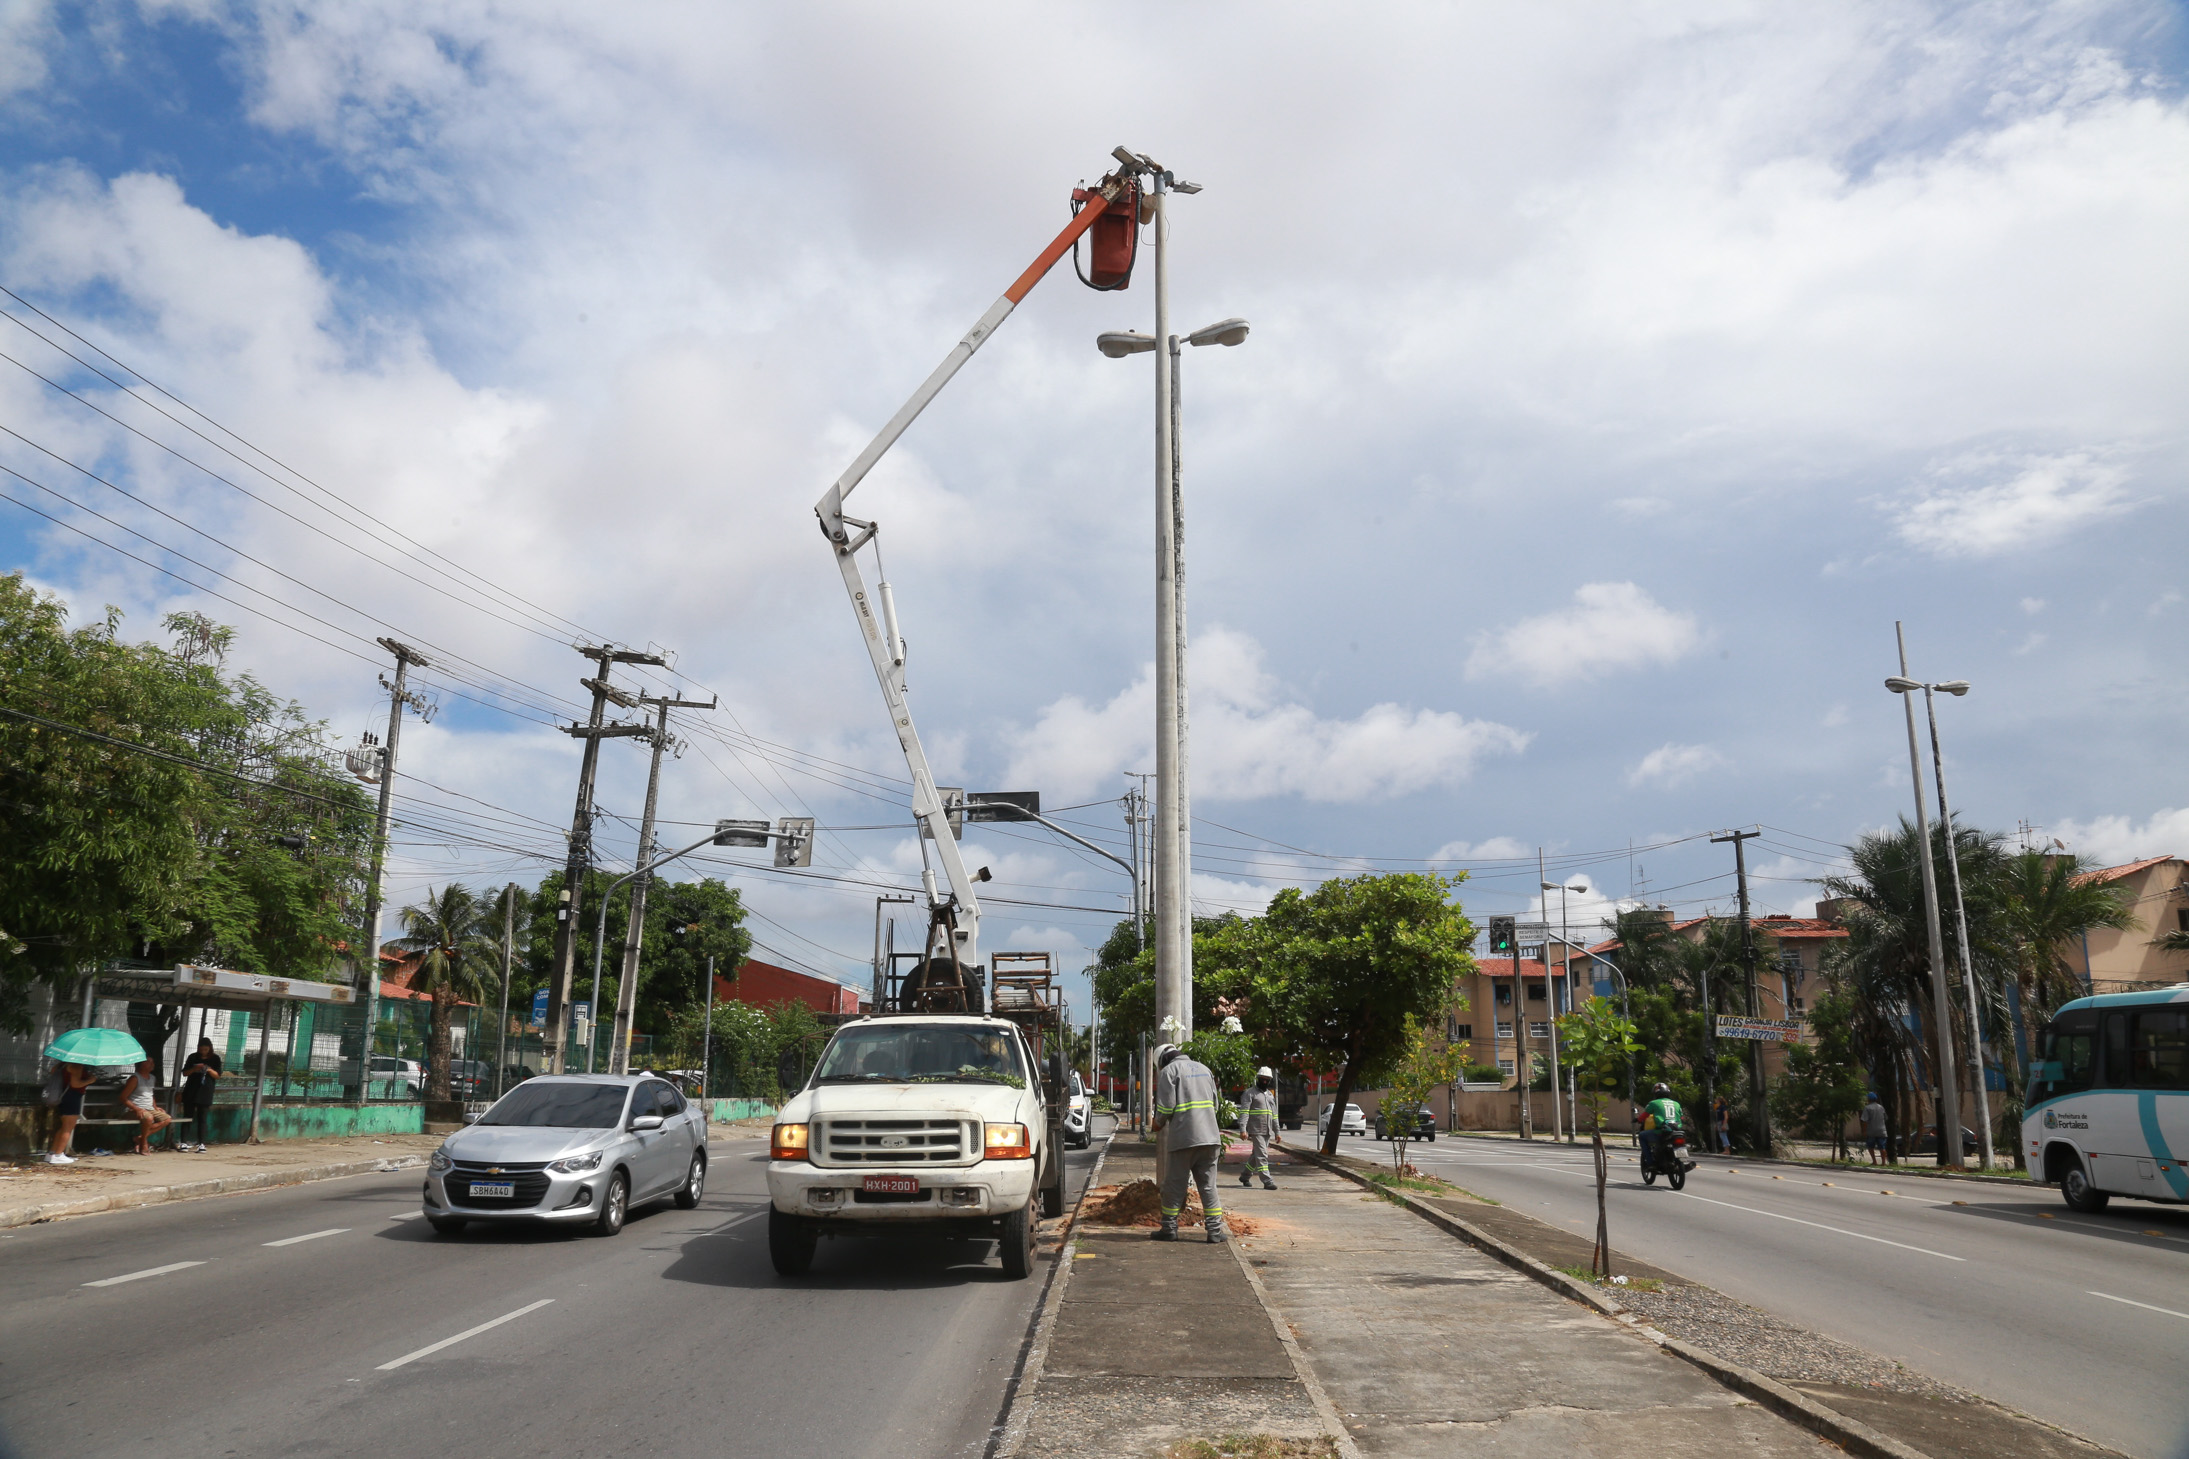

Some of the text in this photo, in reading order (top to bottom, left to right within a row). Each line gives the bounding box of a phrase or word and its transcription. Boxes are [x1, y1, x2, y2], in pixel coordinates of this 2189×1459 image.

[1719, 1016, 1799, 1028] LOTES GRANJA LISBOA
[1725, 1028, 1775, 1040] 99619-6770
[1664, 1105, 1675, 1118] 10
[2058, 1120, 2088, 1129] Fortaleza
[474, 1186, 508, 1195] SBH6A40
